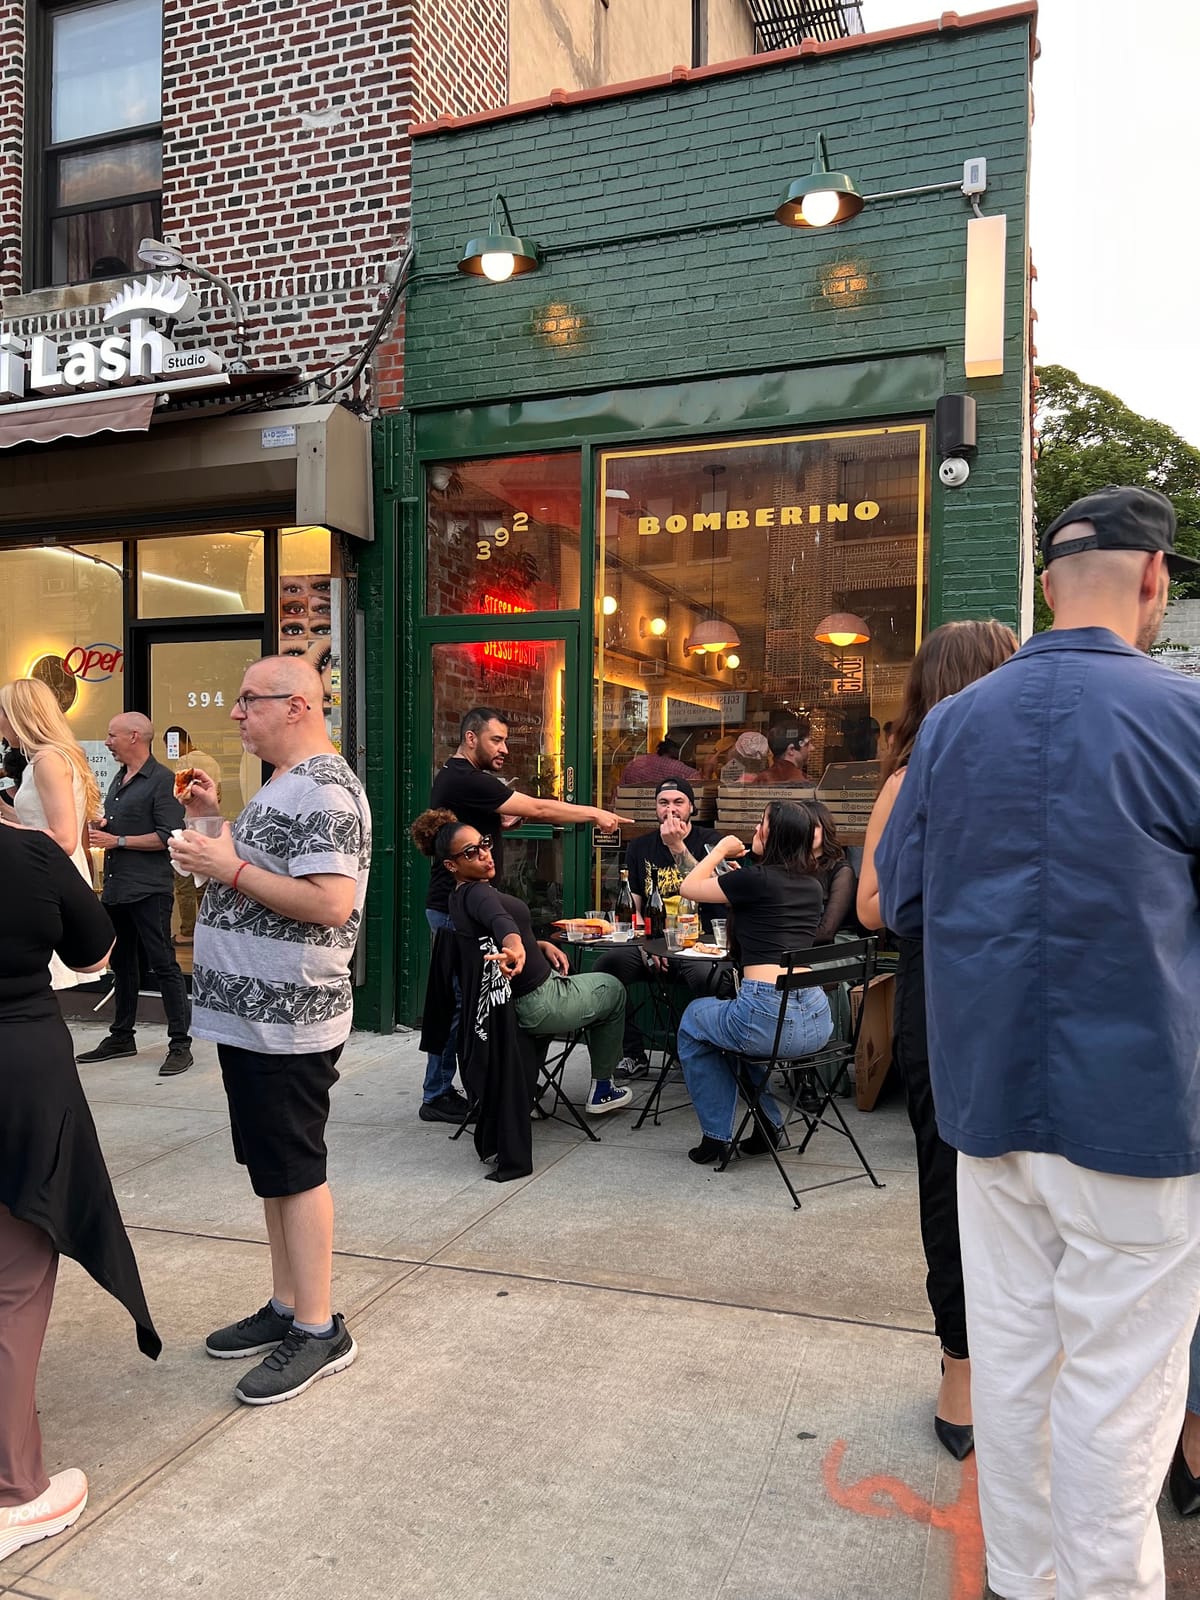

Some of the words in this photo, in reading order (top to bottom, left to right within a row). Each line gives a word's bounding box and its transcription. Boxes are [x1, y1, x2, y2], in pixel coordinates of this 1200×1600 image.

[31, 319, 165, 388] Lash
[168, 353, 206, 369] Studio
[638, 500, 880, 536] BOMBERINO
[187, 690, 225, 708] 394
[8, 1502, 51, 1524] HOKA
